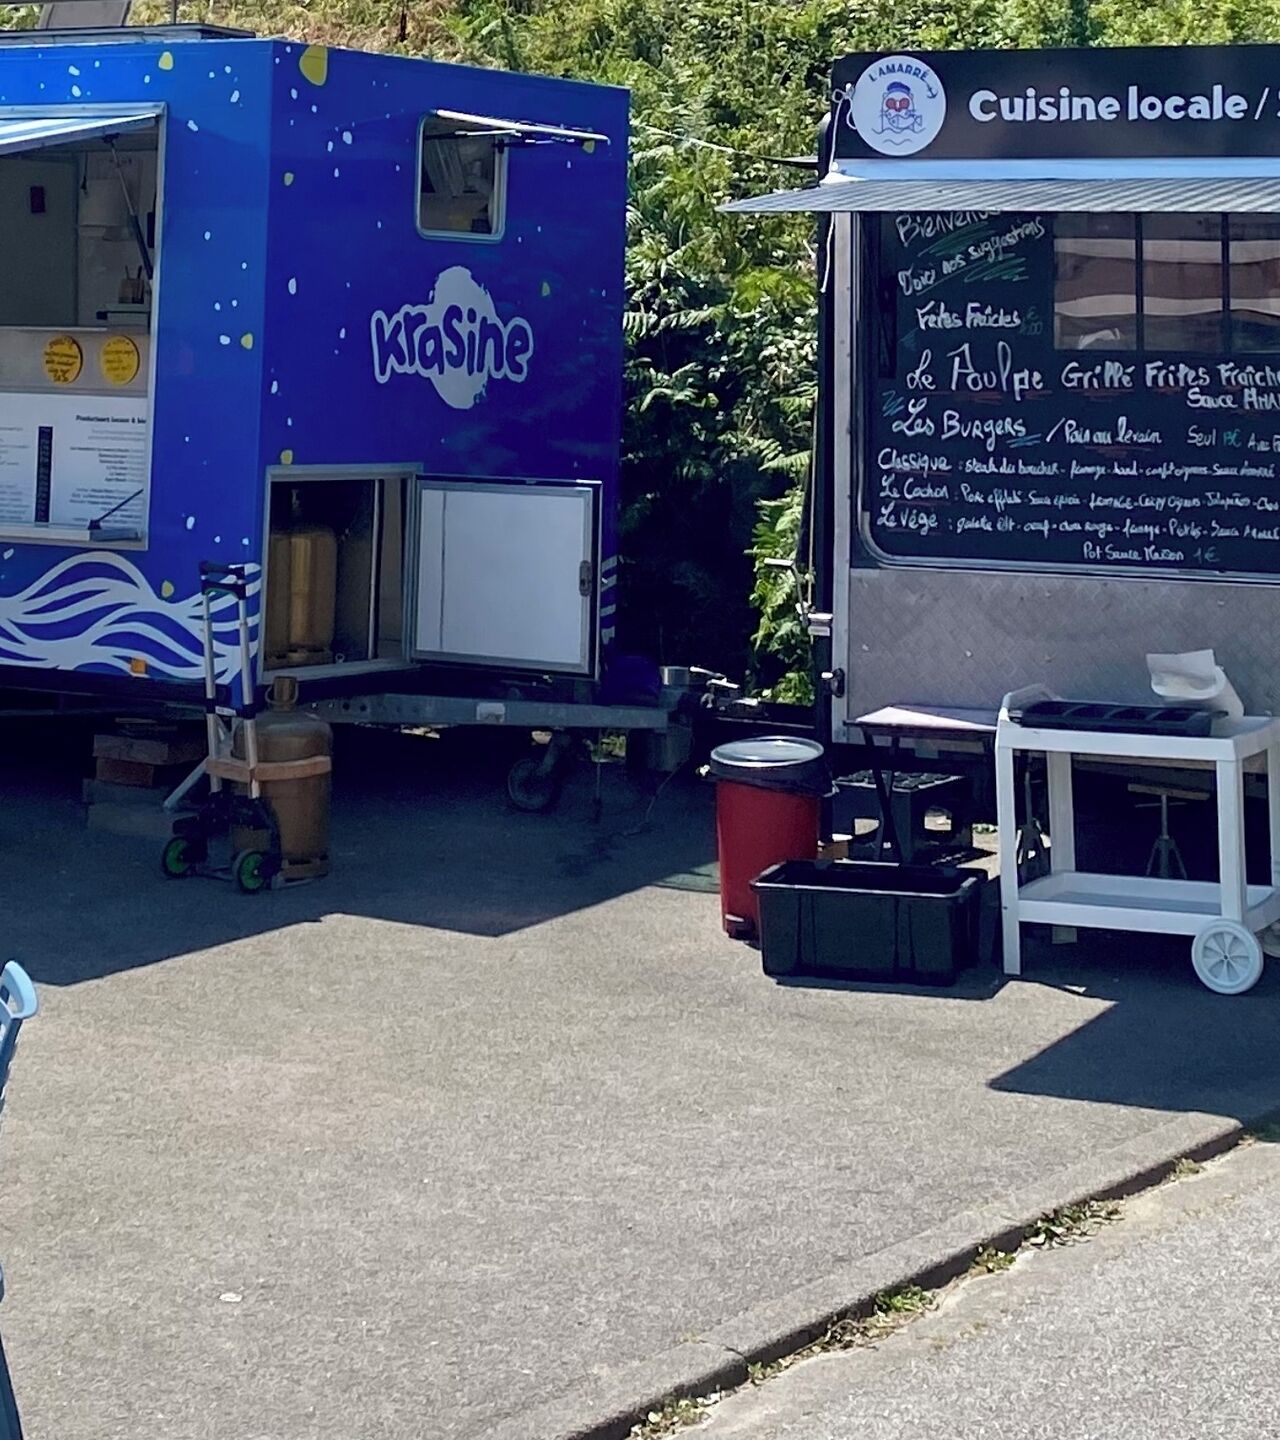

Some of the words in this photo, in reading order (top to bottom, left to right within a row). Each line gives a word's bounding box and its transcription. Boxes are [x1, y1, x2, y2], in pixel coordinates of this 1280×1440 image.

[969, 87, 1120, 122] Cuisine
[1127, 82, 1248, 120] locale
[895, 210, 1001, 248] Bienvenu
[946, 340, 1044, 402] Poulpe
[1187, 425, 1217, 447] Seul
